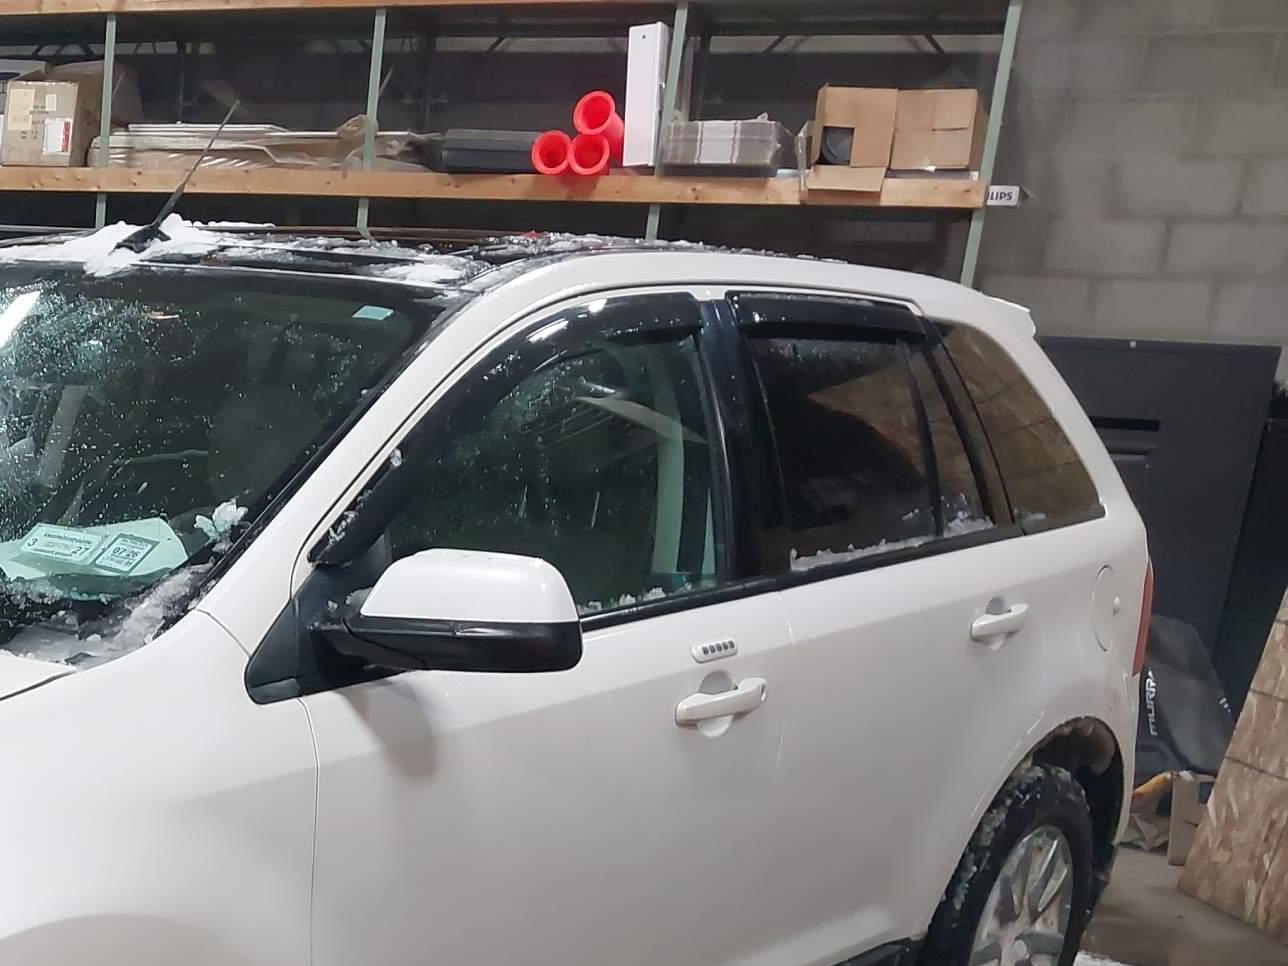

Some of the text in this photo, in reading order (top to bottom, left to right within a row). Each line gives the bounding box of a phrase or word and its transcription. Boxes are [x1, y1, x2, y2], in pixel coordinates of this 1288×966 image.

[27, 538, 38, 547] 3
[71, 545, 90, 557] 27
[113, 547, 127, 555] 07
